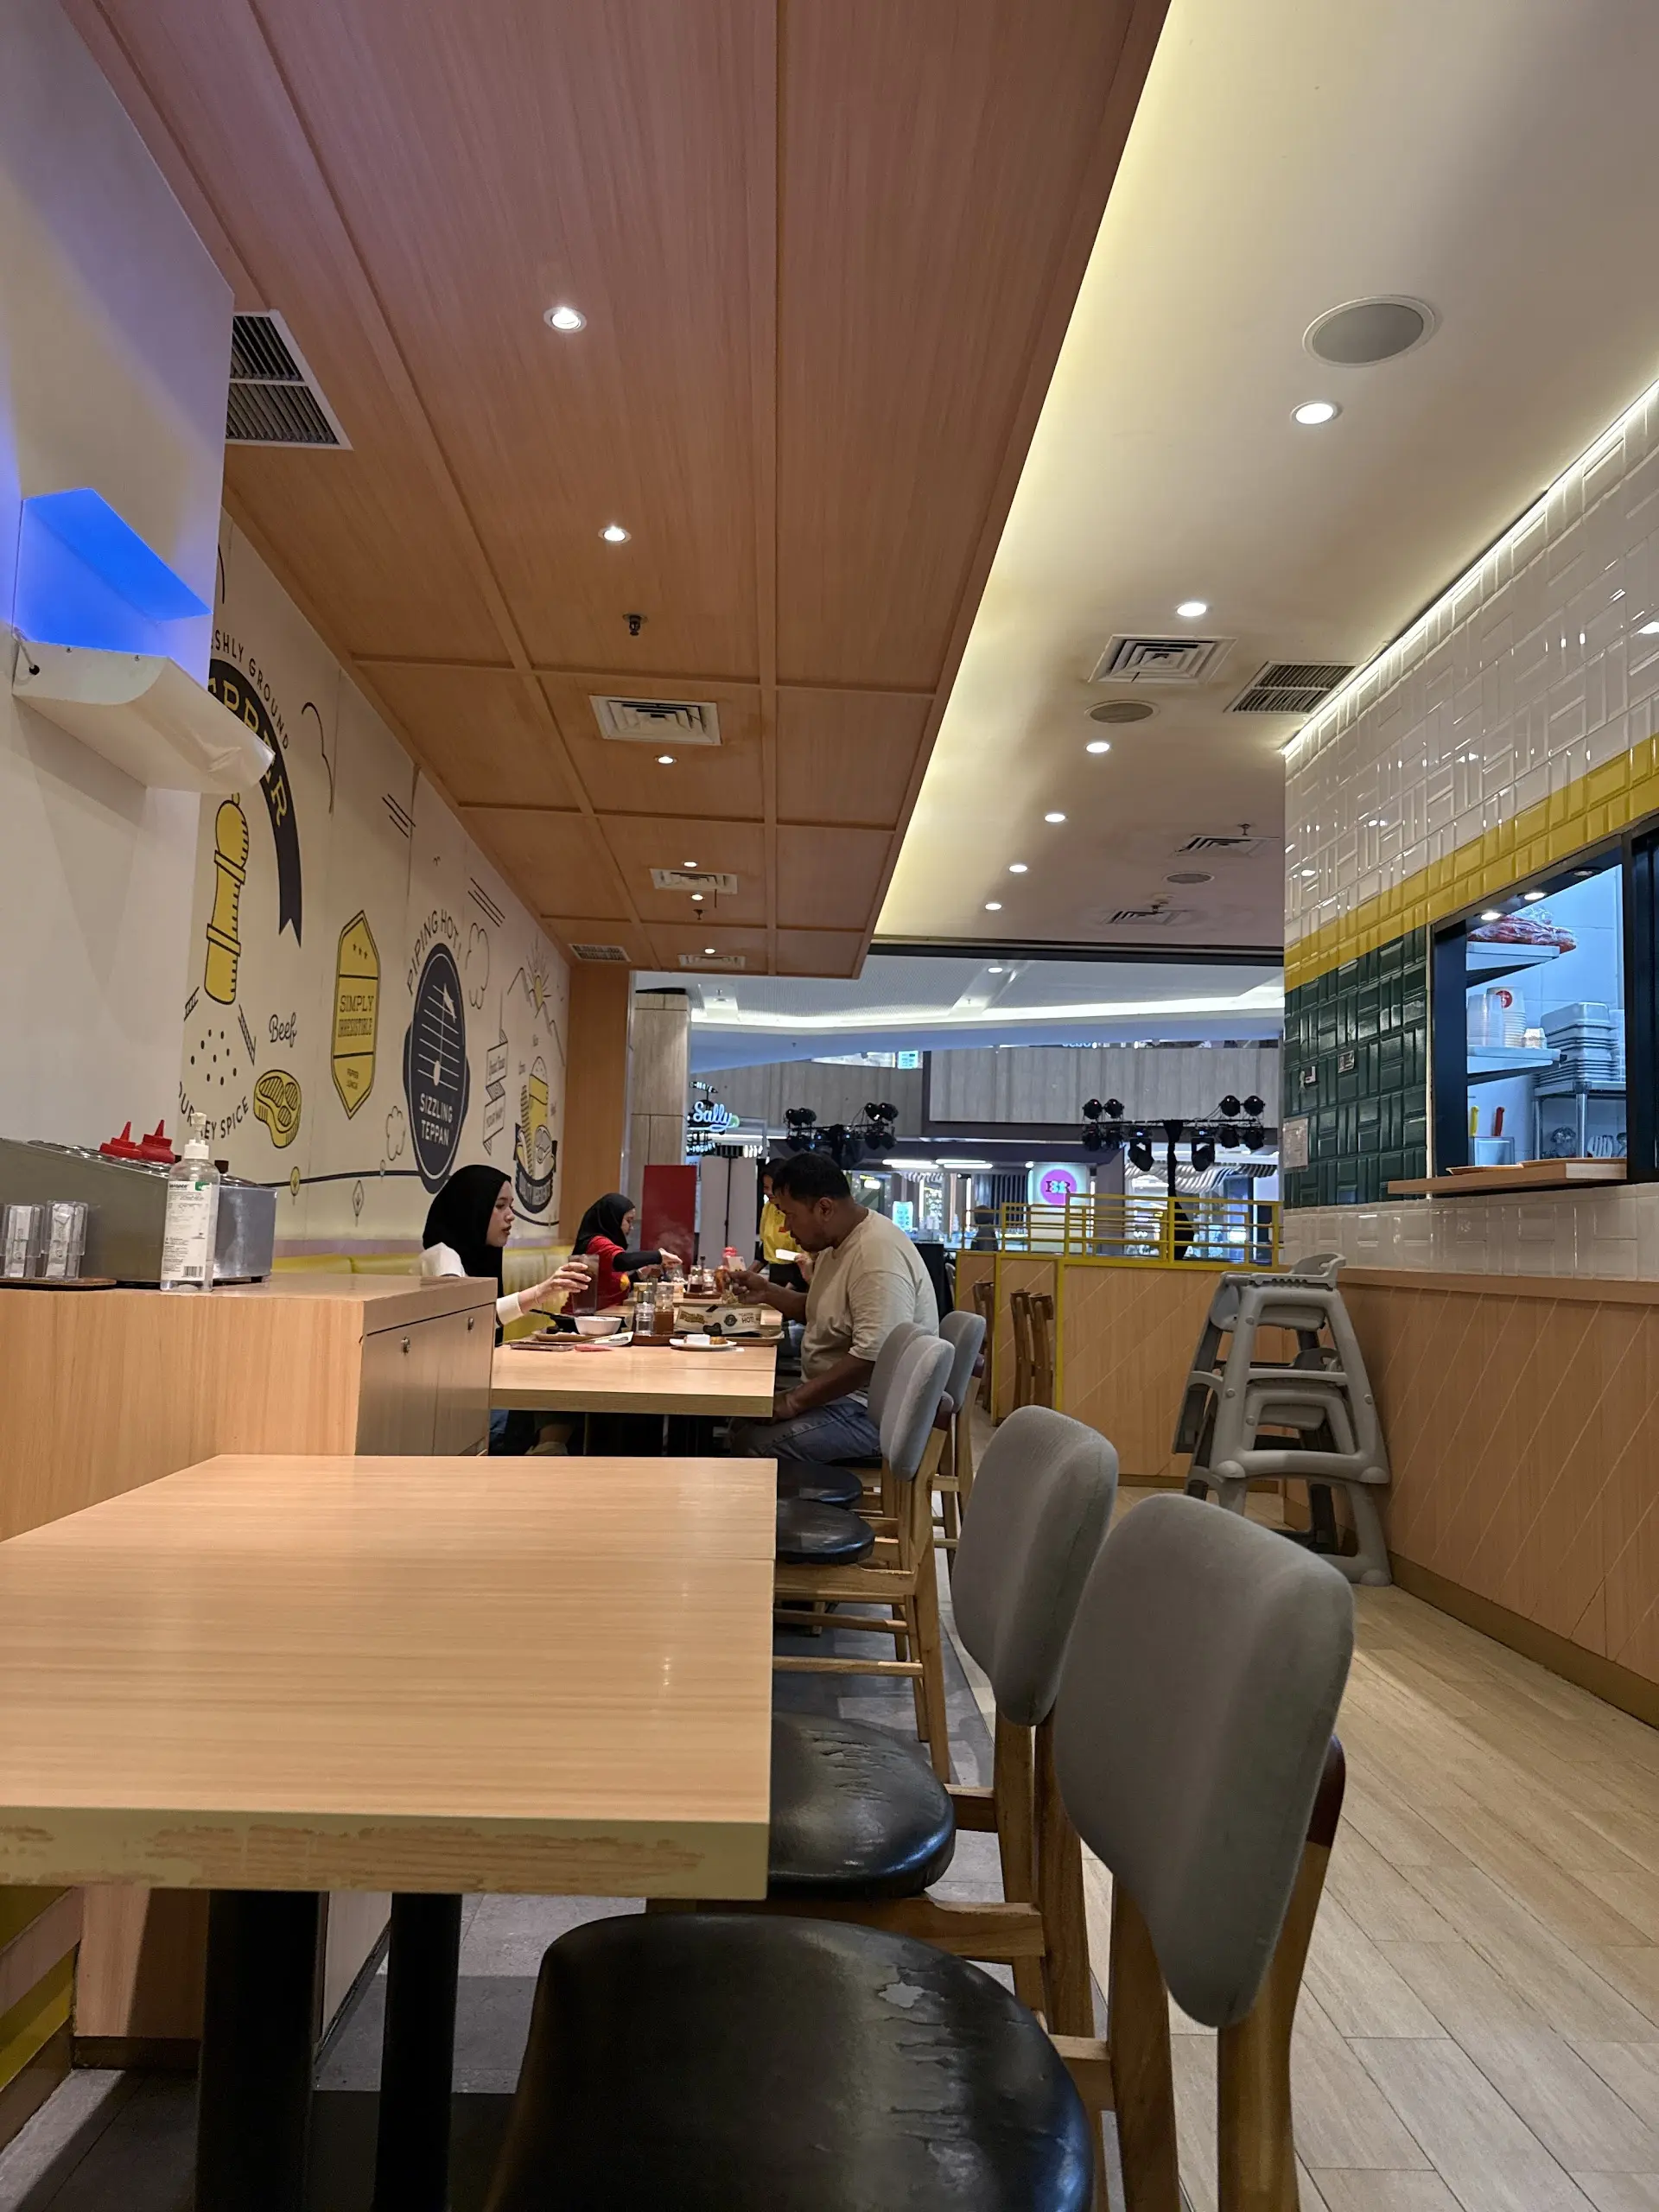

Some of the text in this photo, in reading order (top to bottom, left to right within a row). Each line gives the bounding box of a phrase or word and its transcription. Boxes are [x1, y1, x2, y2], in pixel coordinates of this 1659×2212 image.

[249, 658, 289, 750] GROUND
[407, 909, 461, 995] PIPING HOT!
[340, 995, 374, 1012] SIMPLY
[269, 1012, 297, 1048] Beef
[220, 1096, 249, 1139] SPICE
[419, 1093, 453, 1122] SIZZLING
[693, 1101, 733, 1132] Sally
[421, 1120, 449, 1147] TEPPAN
